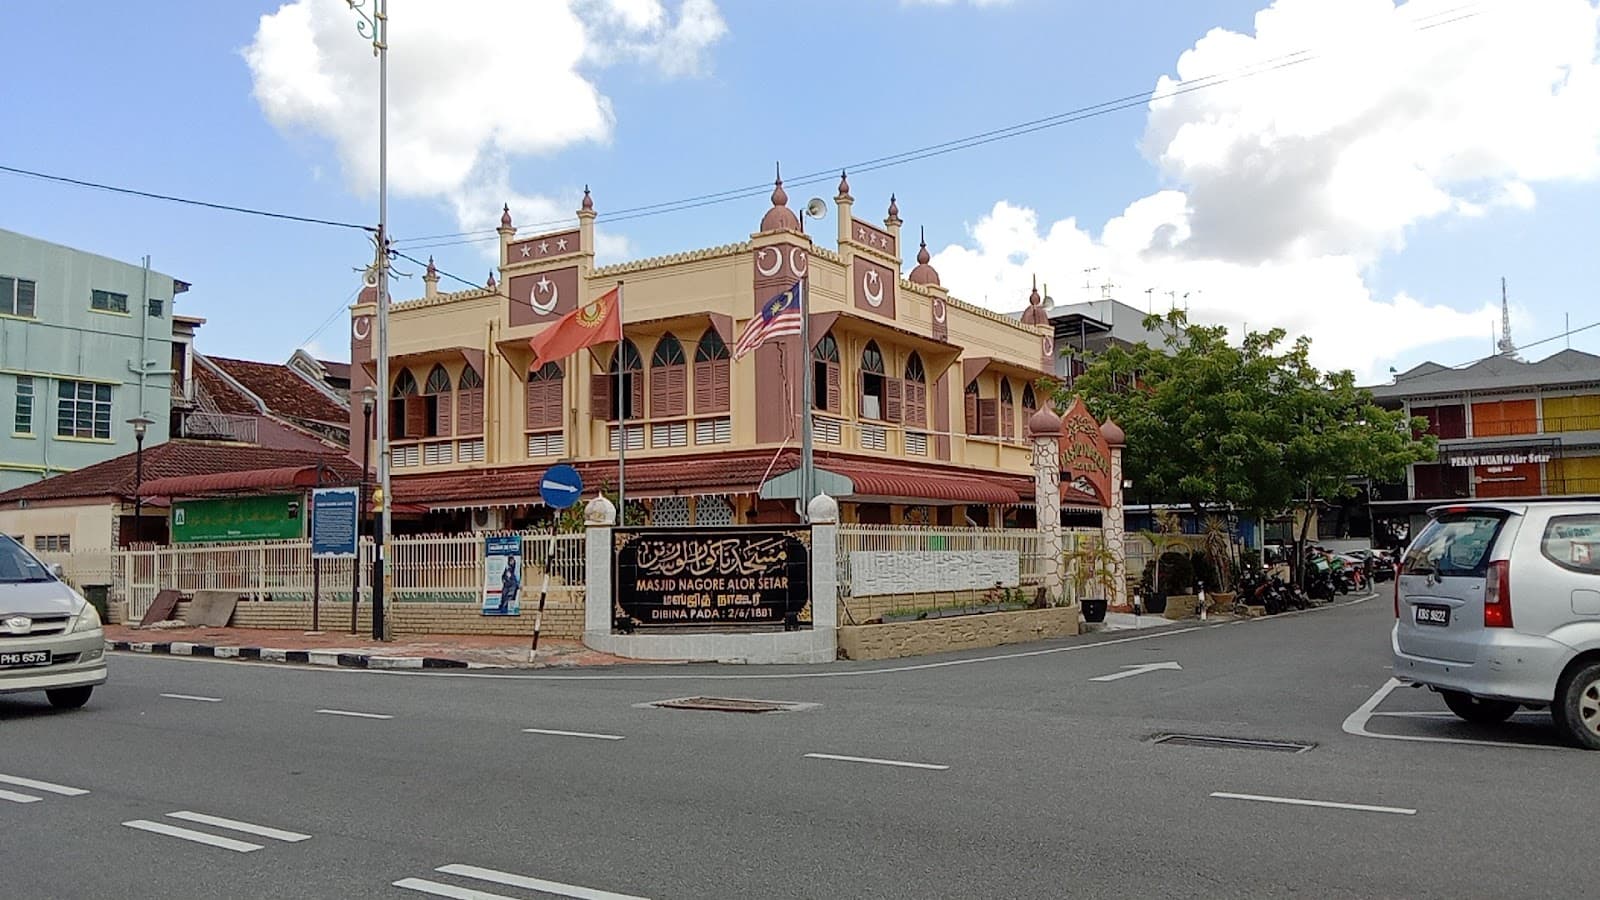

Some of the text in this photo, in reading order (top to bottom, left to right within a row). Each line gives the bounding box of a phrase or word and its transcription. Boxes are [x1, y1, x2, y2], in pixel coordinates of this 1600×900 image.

[636, 577, 788, 592] MASJID NAGORE ALOR SETAR
[651, 610, 688, 620] DIBINA
[690, 609, 720, 619] PADA
[22, 652, 47, 662] 6575
